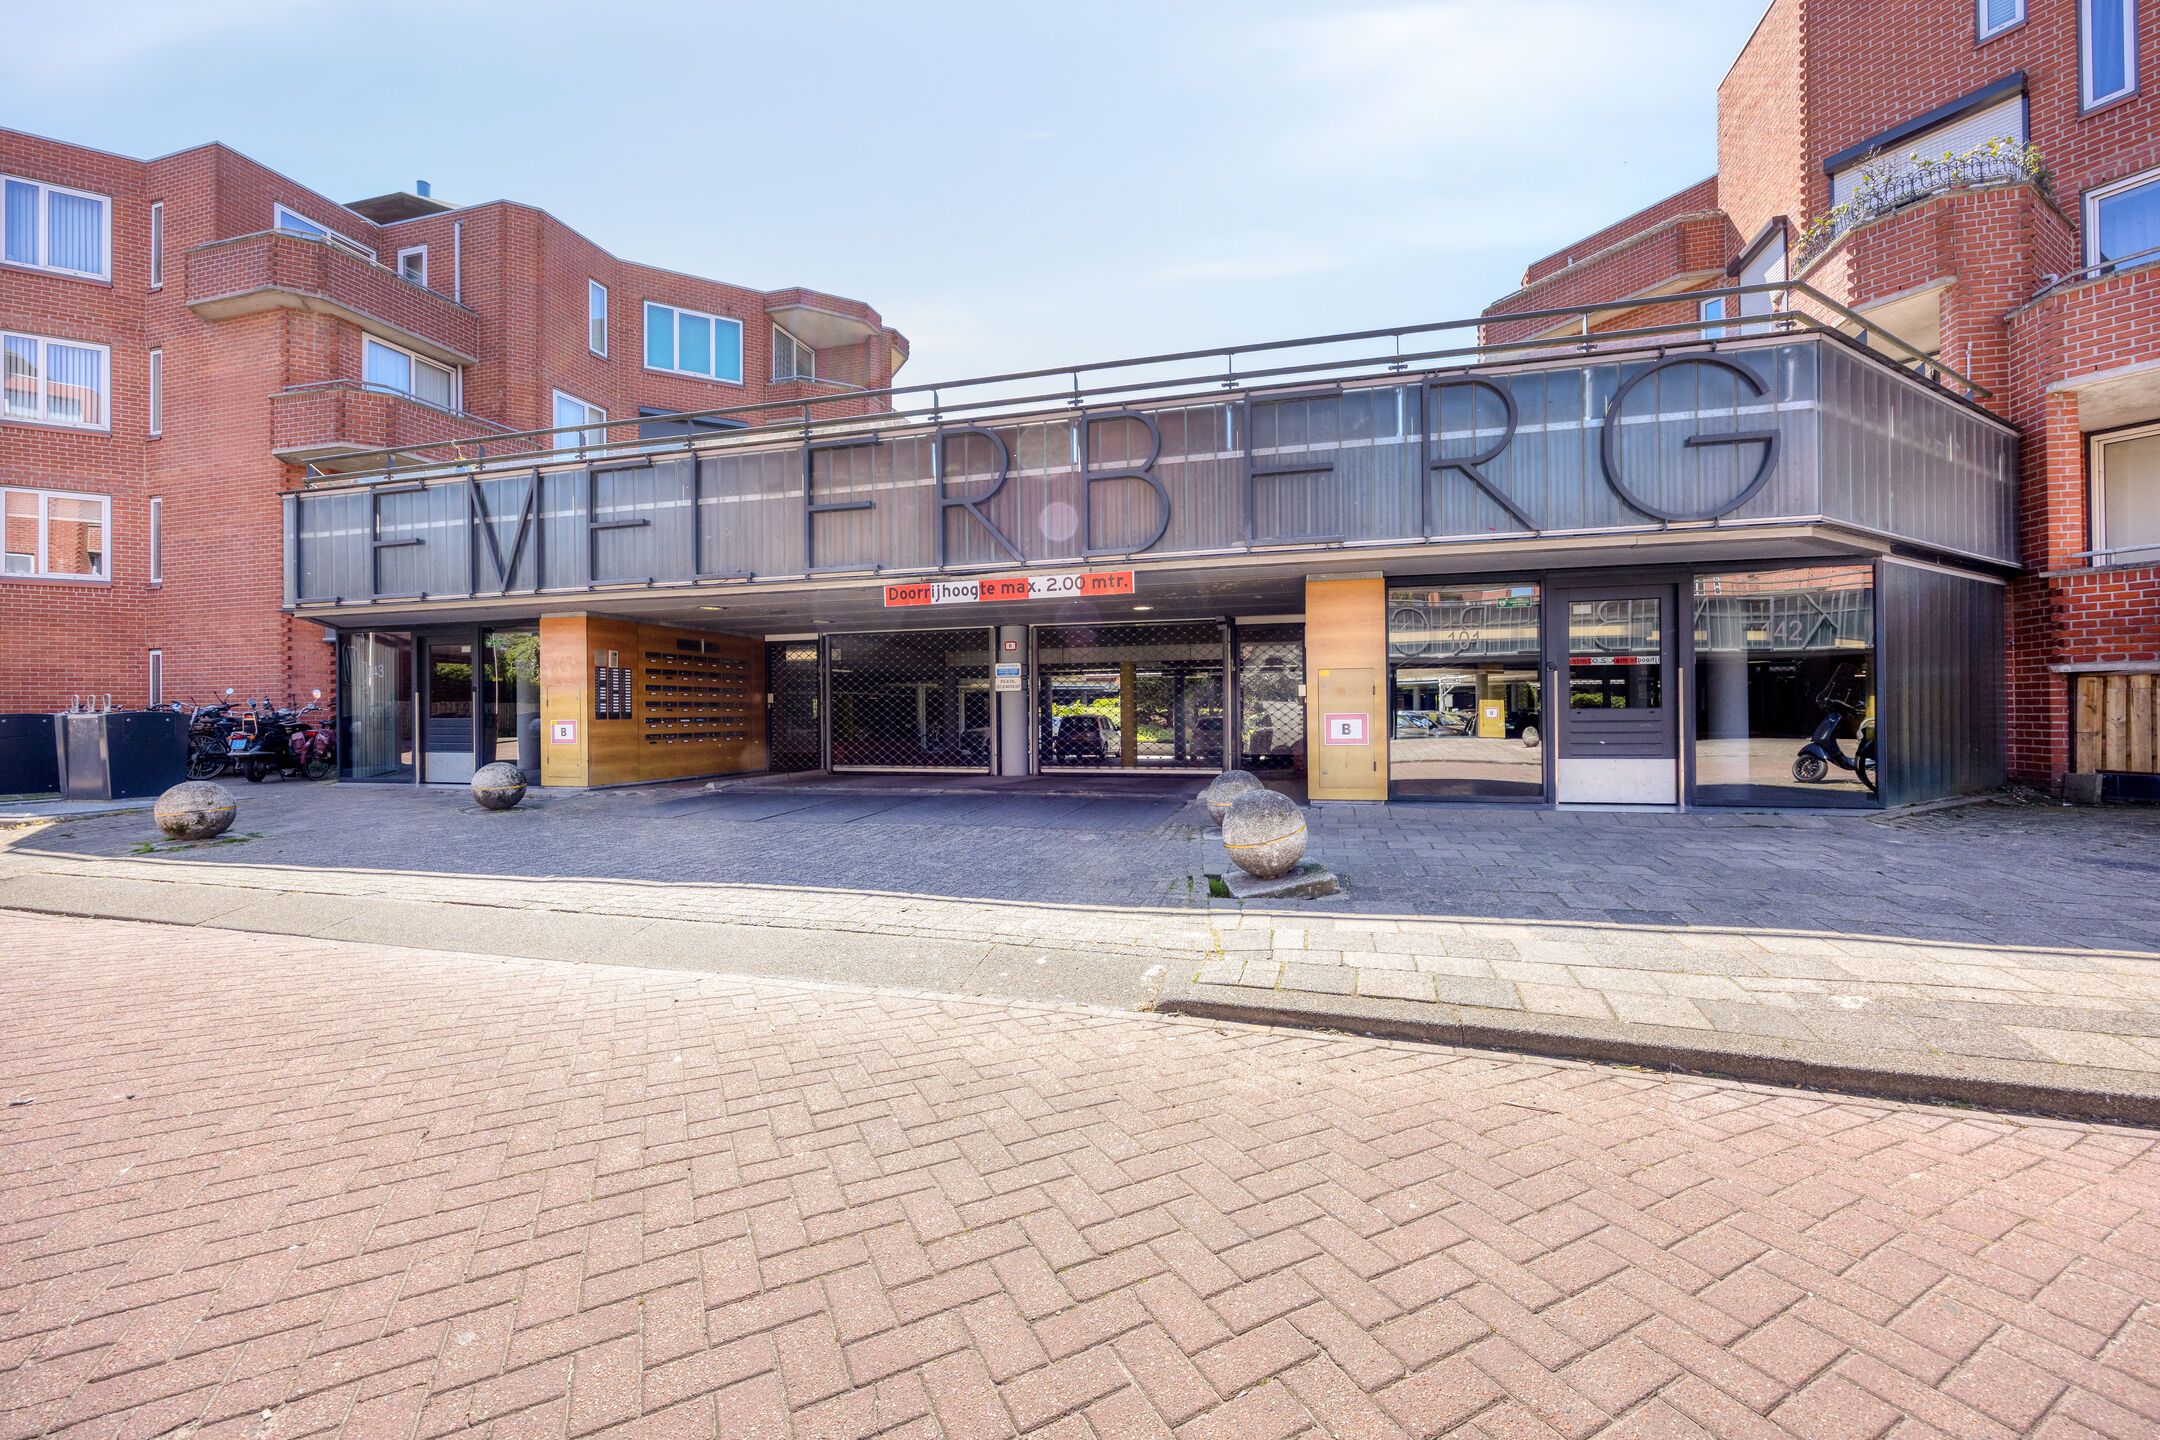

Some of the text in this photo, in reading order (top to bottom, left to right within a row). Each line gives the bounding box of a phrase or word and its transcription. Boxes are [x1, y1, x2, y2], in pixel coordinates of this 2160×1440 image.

[293, 351, 1781, 603] LEMELERBERG
[889, 575, 1128, 602] Doorrijhoogte max. 2.00 mtr.
[1448, 630, 1480, 650] 101
[1761, 620, 1803, 641] 142
[560, 727, 567, 737] B
[1341, 723, 1352, 736] B
